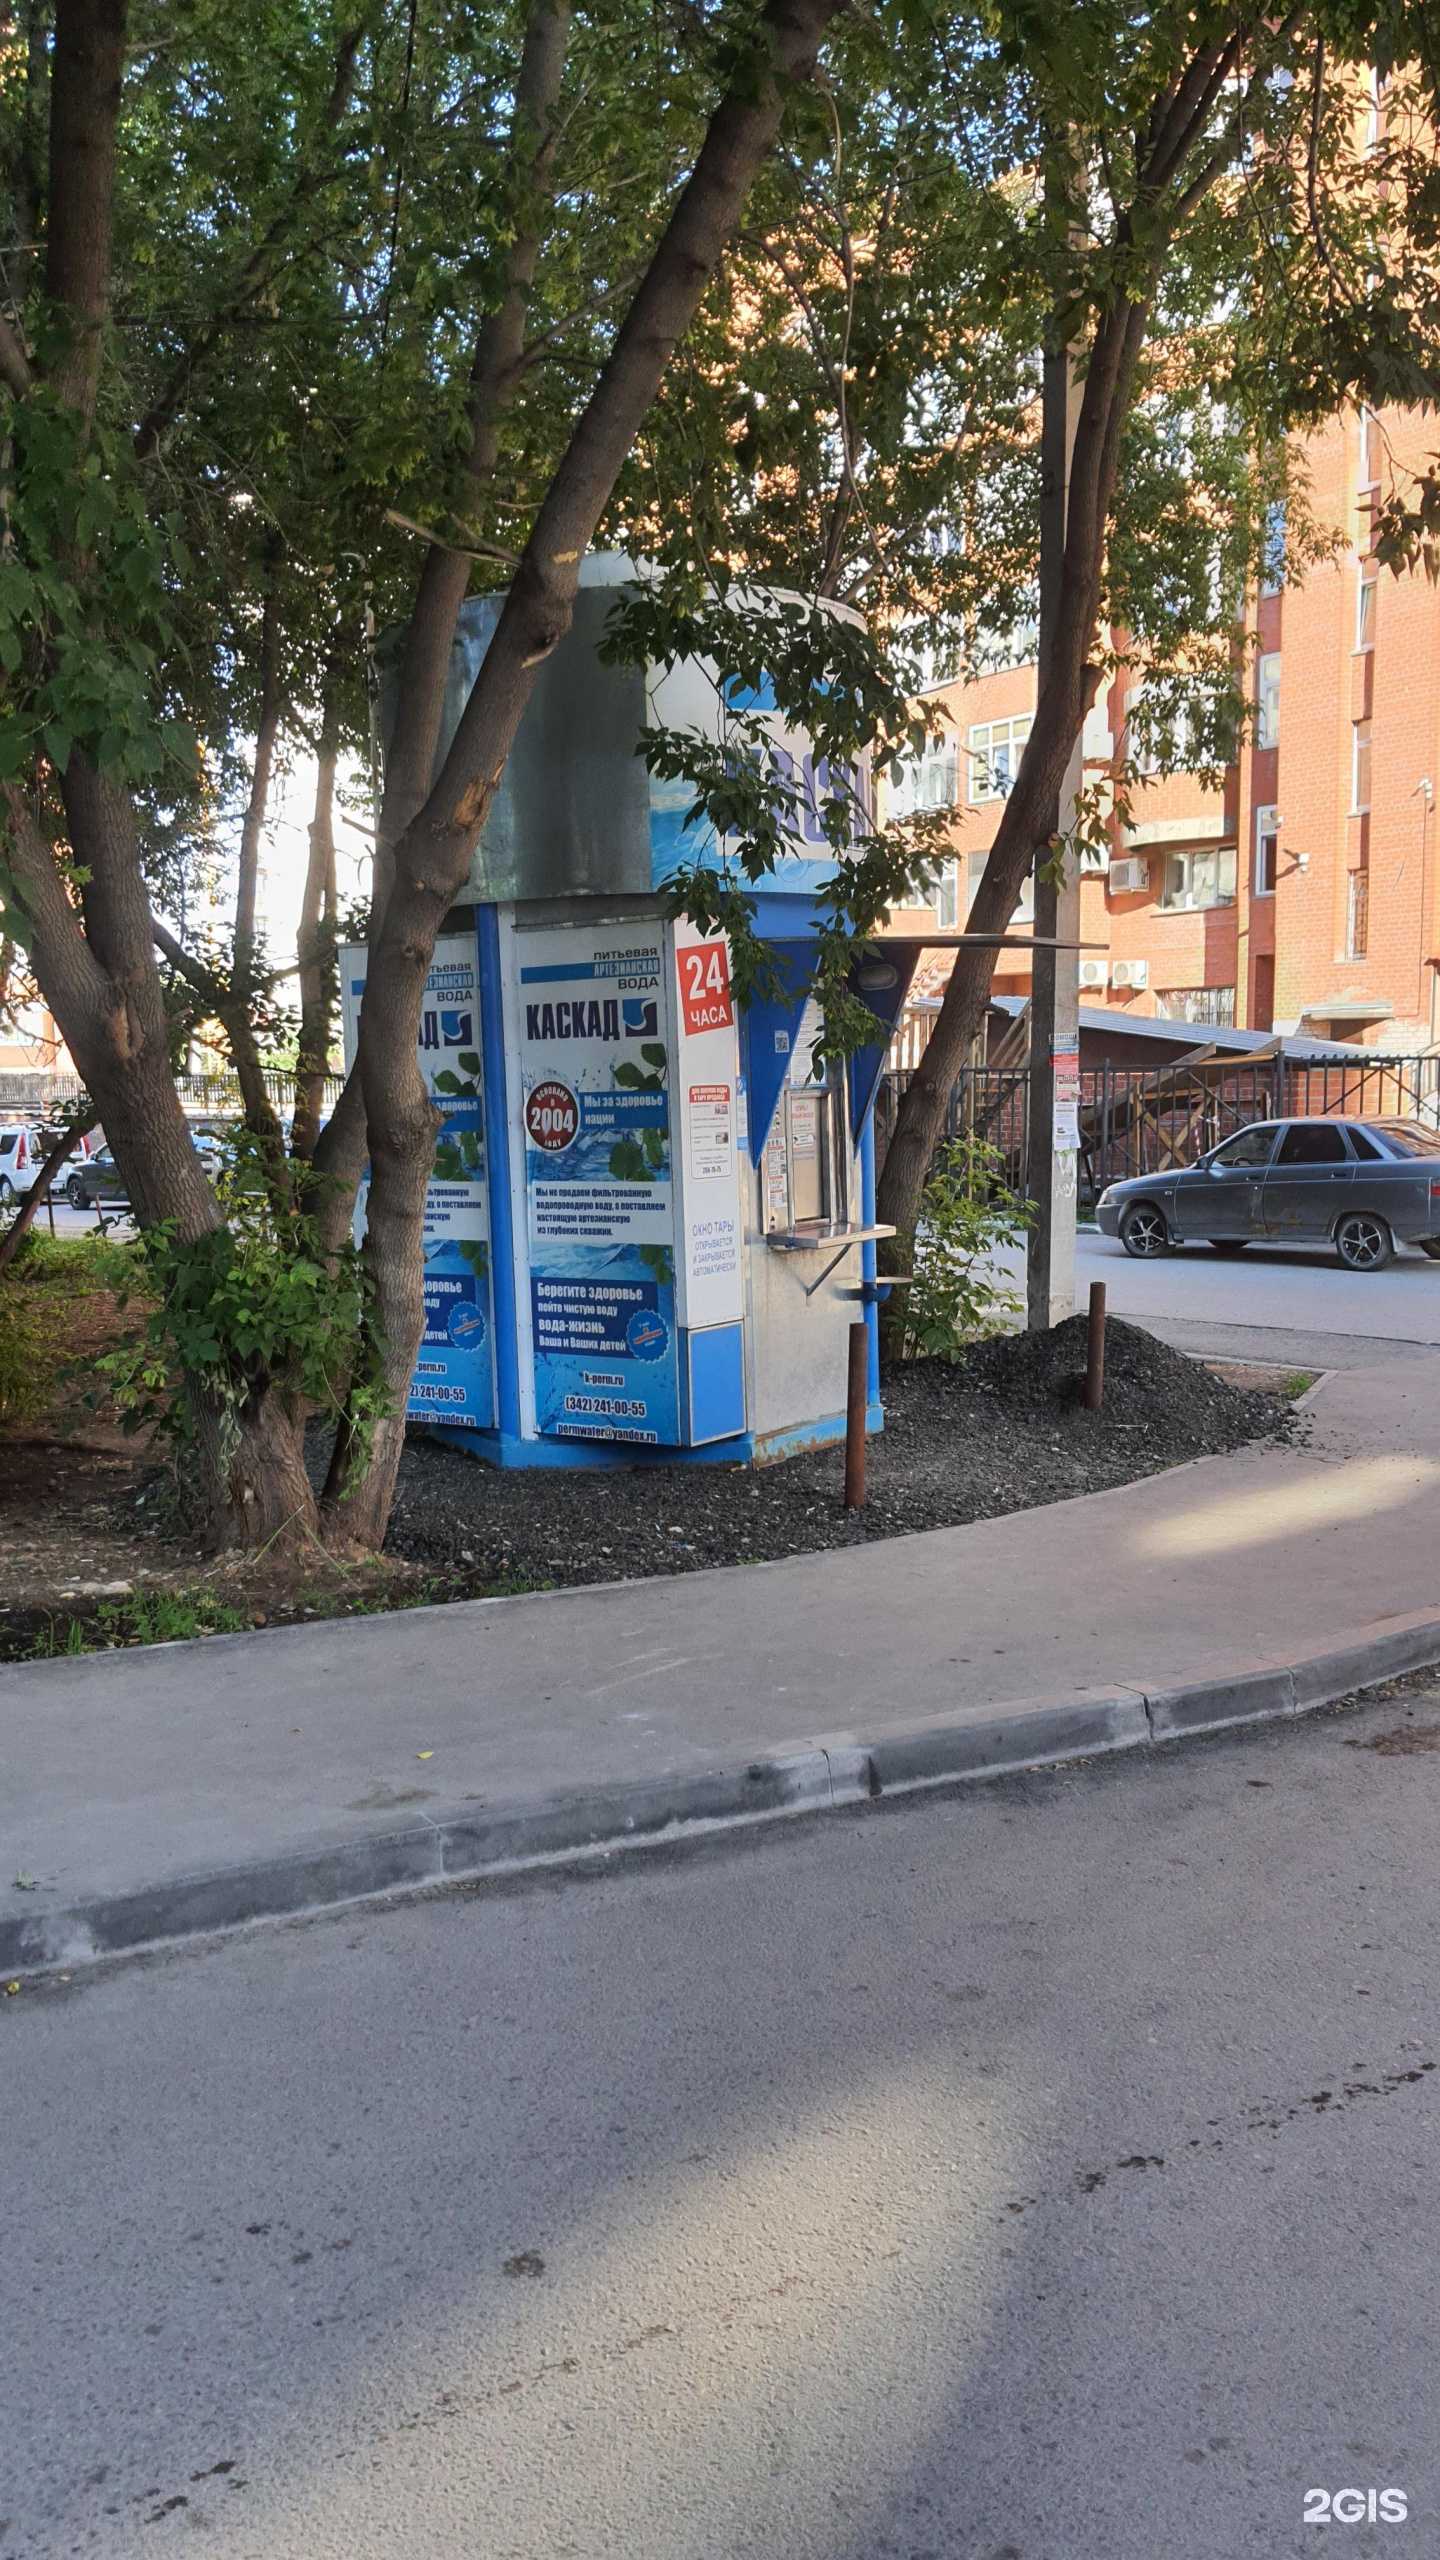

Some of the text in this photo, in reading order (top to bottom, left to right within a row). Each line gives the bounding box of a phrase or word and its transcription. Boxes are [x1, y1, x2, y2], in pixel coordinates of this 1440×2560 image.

[593, 947, 658, 960] питьевая
[617, 976, 659, 990] ВОДА
[686, 951, 724, 1000] 24
[436, 990, 473, 1002] ВОДА
[525, 1000, 621, 1041] КАСКАД
[690, 1005, 728, 1027] ЧАСА
[584, 1096, 663, 1109] Мы за здоровье
[530, 1107, 574, 1133] 2004
[585, 1114, 615, 1125] нации
[692, 1219, 735, 1237] ОКНО ТАРЫ
[537, 1282, 643, 1300] Берегите здоровье
[537, 1301, 618, 1317] пейте чистую воду
[539, 1335, 626, 1351] Ваша и Ваших детей
[420, 1385, 465, 1401] 241-00-55
[565, 1396, 646, 1417] (342) 241-00-55
[557, 1423, 657, 1442] permwater@yandex.ru
